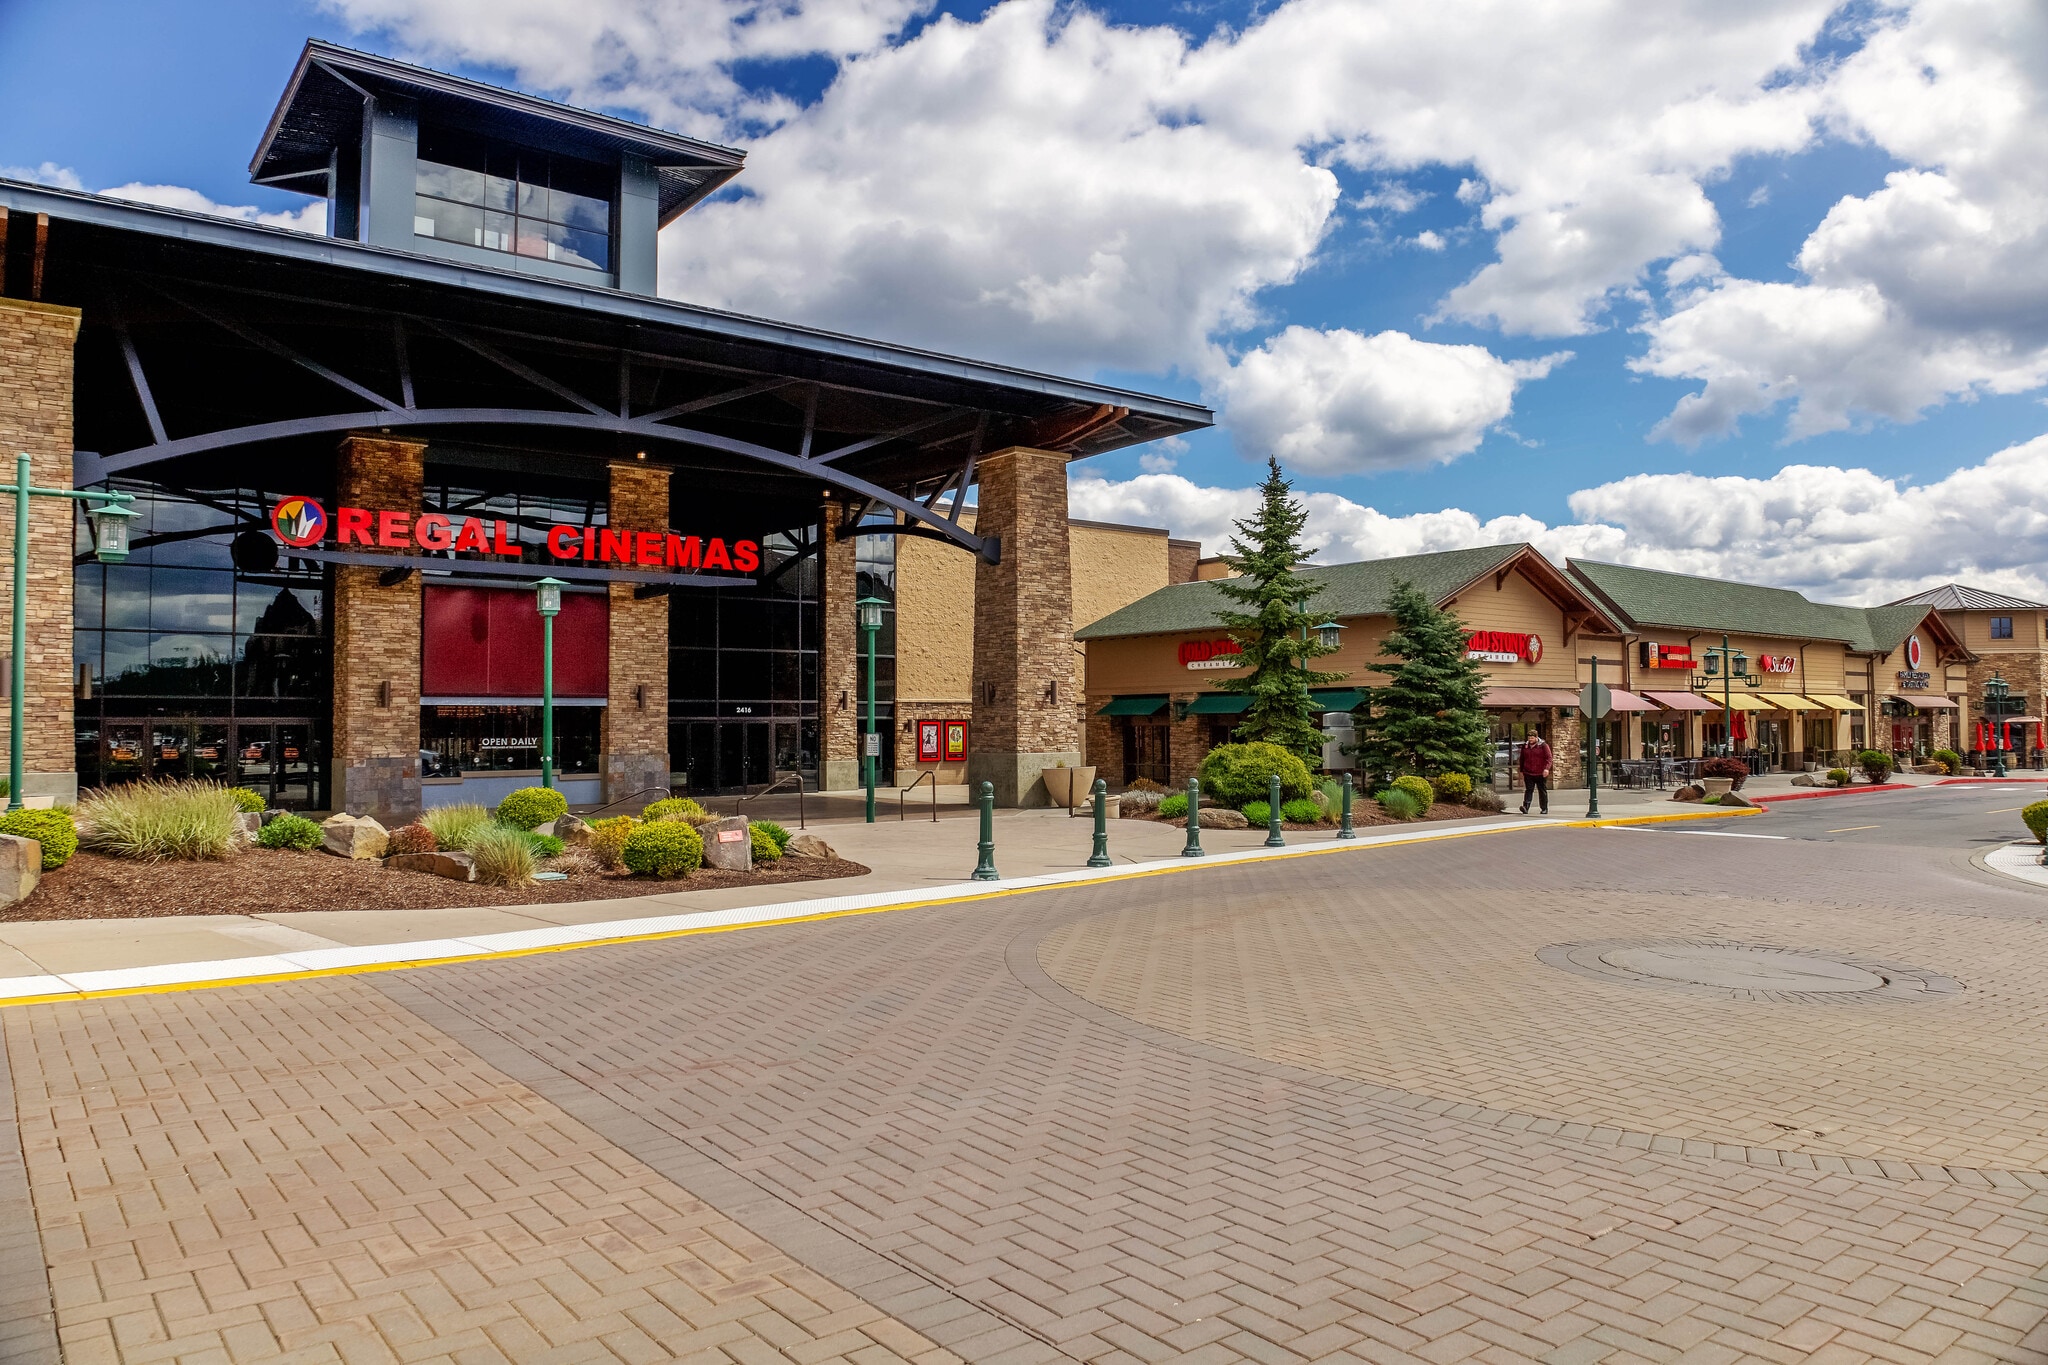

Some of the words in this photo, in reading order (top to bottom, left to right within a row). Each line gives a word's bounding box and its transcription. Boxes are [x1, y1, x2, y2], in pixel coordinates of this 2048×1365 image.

[337, 507, 523, 555] REGAL
[547, 525, 759, 572] CINEMAS
[1491, 631, 1528, 658] STONE
[482, 738, 508, 746] OPEN
[511, 737, 538, 746] DAILY
